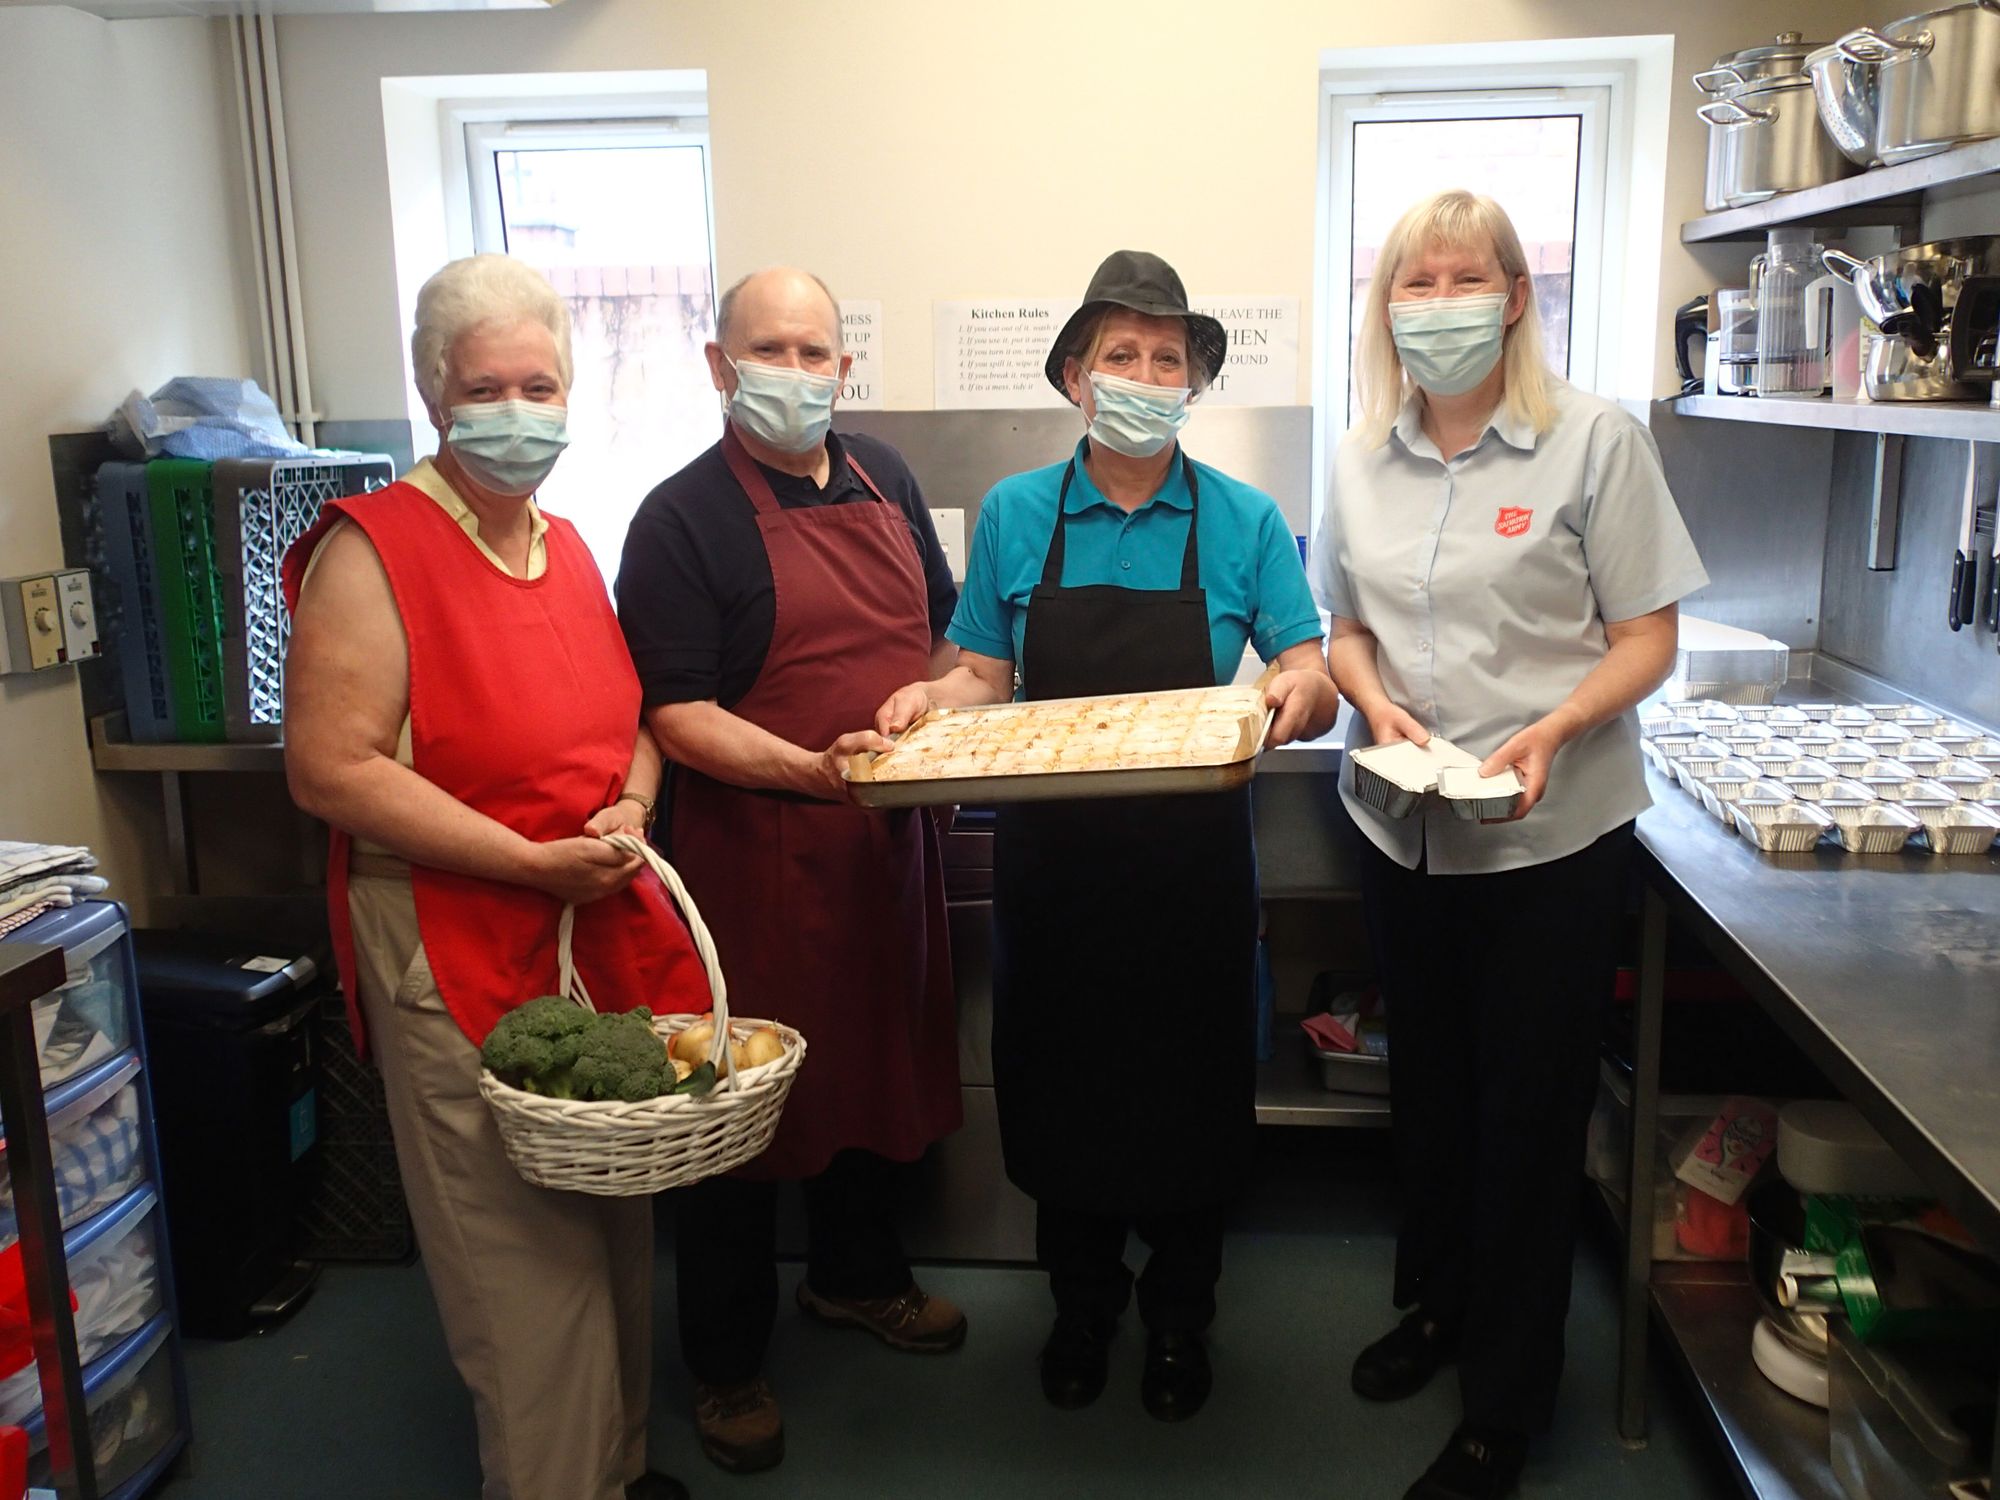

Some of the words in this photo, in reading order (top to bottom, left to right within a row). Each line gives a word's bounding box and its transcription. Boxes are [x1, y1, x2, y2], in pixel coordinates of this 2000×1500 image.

[971, 308, 1014, 319] Kitchen
[1019, 308, 1049, 318] Rules
[1212, 308, 1254, 319] LEAVE
[1257, 308, 1282, 319] THE
[854, 332, 870, 342] UP
[1226, 328, 1268, 346] HEN
[841, 384, 870, 400] OU
